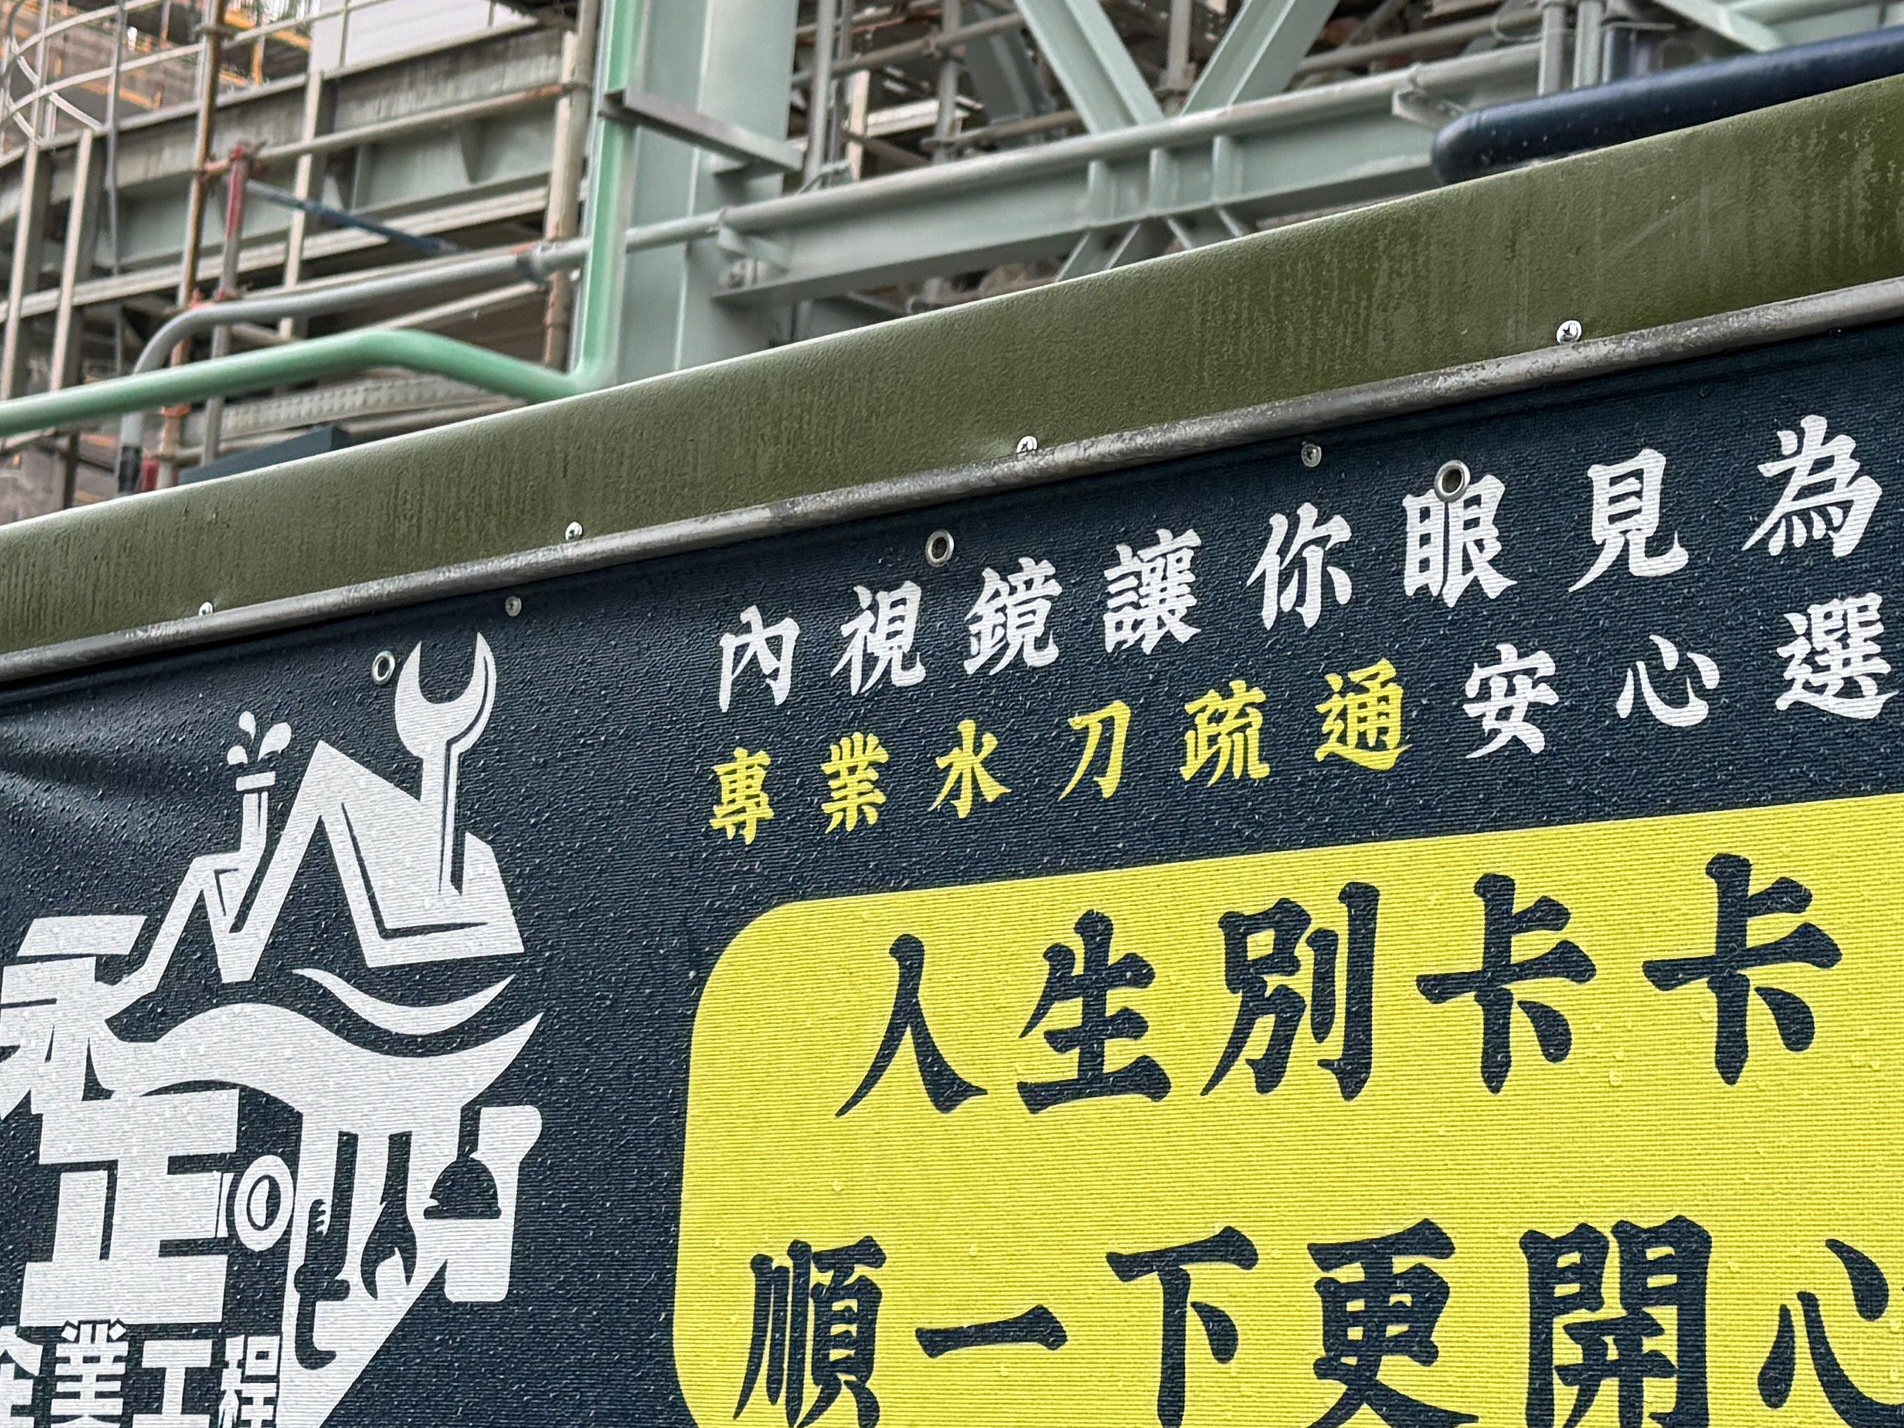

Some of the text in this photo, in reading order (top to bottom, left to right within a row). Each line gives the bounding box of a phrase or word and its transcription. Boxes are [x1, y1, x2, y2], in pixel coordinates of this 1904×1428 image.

[834, 851, 1845, 1120] 人生別卡卡
